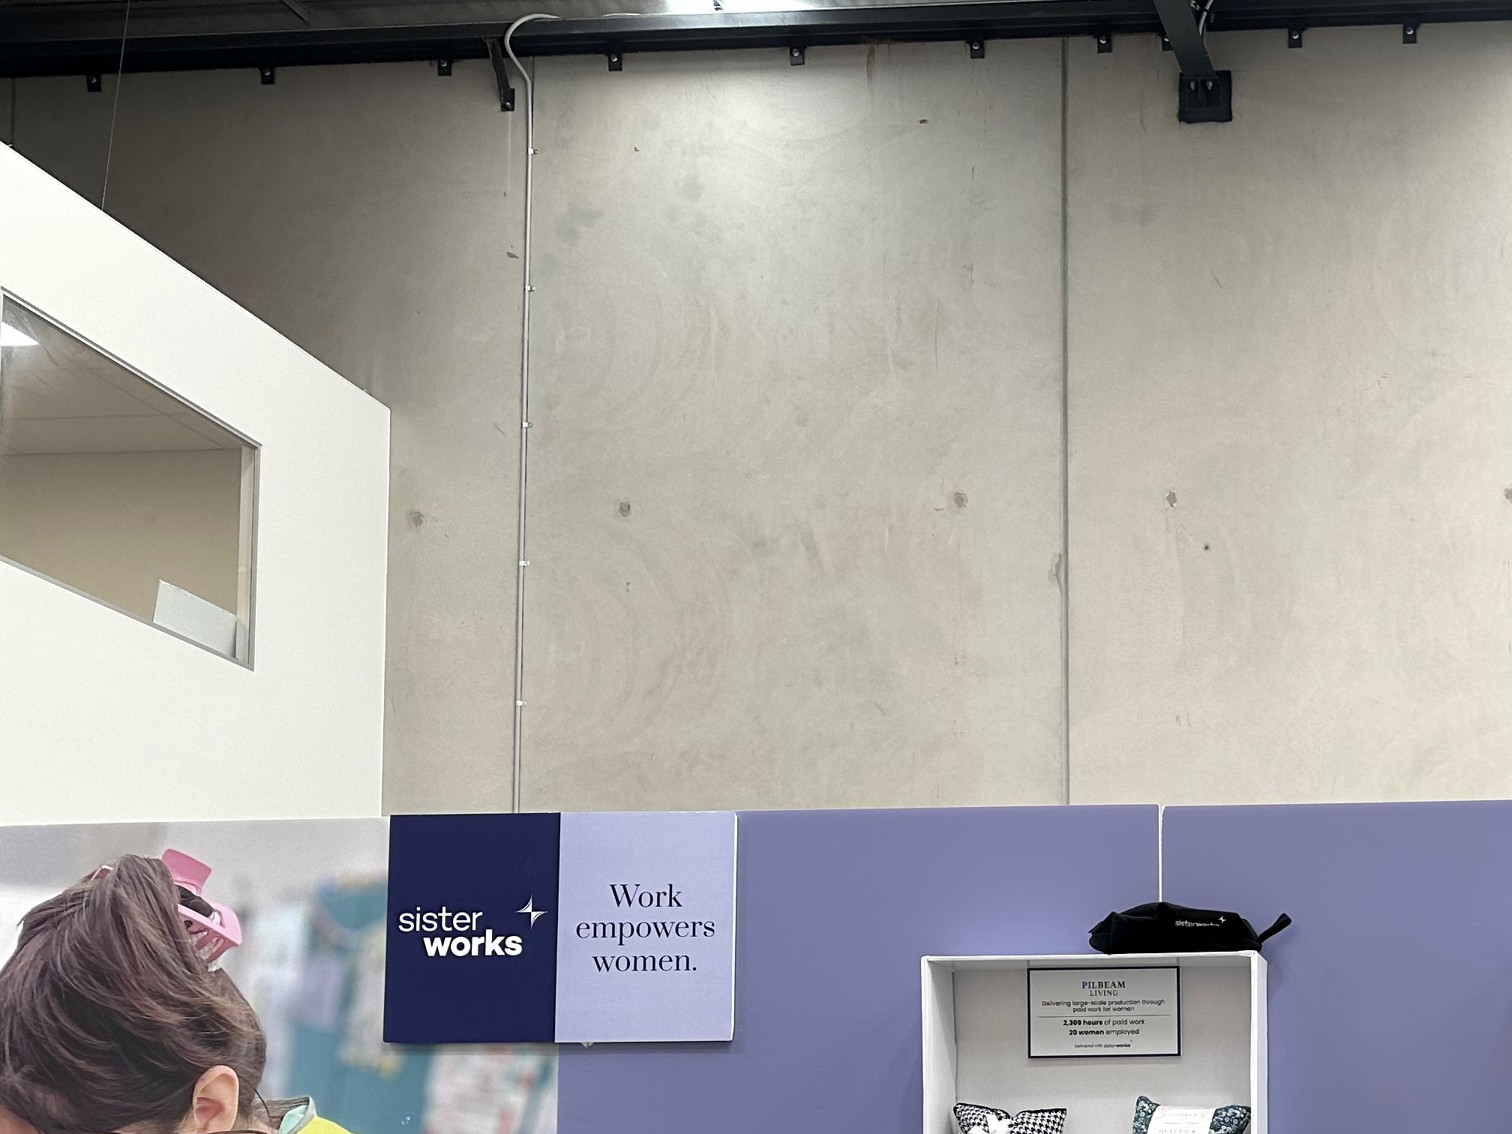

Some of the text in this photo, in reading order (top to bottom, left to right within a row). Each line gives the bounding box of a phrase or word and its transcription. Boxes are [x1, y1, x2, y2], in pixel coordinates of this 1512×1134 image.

[609, 883, 682, 908] Work
[398, 907, 482, 932] sister
[424, 929, 522, 957] works
[576, 920, 715, 945] empowers
[592, 954, 697, 972] women.
[1082, 981, 1125, 989] PILBEAM
